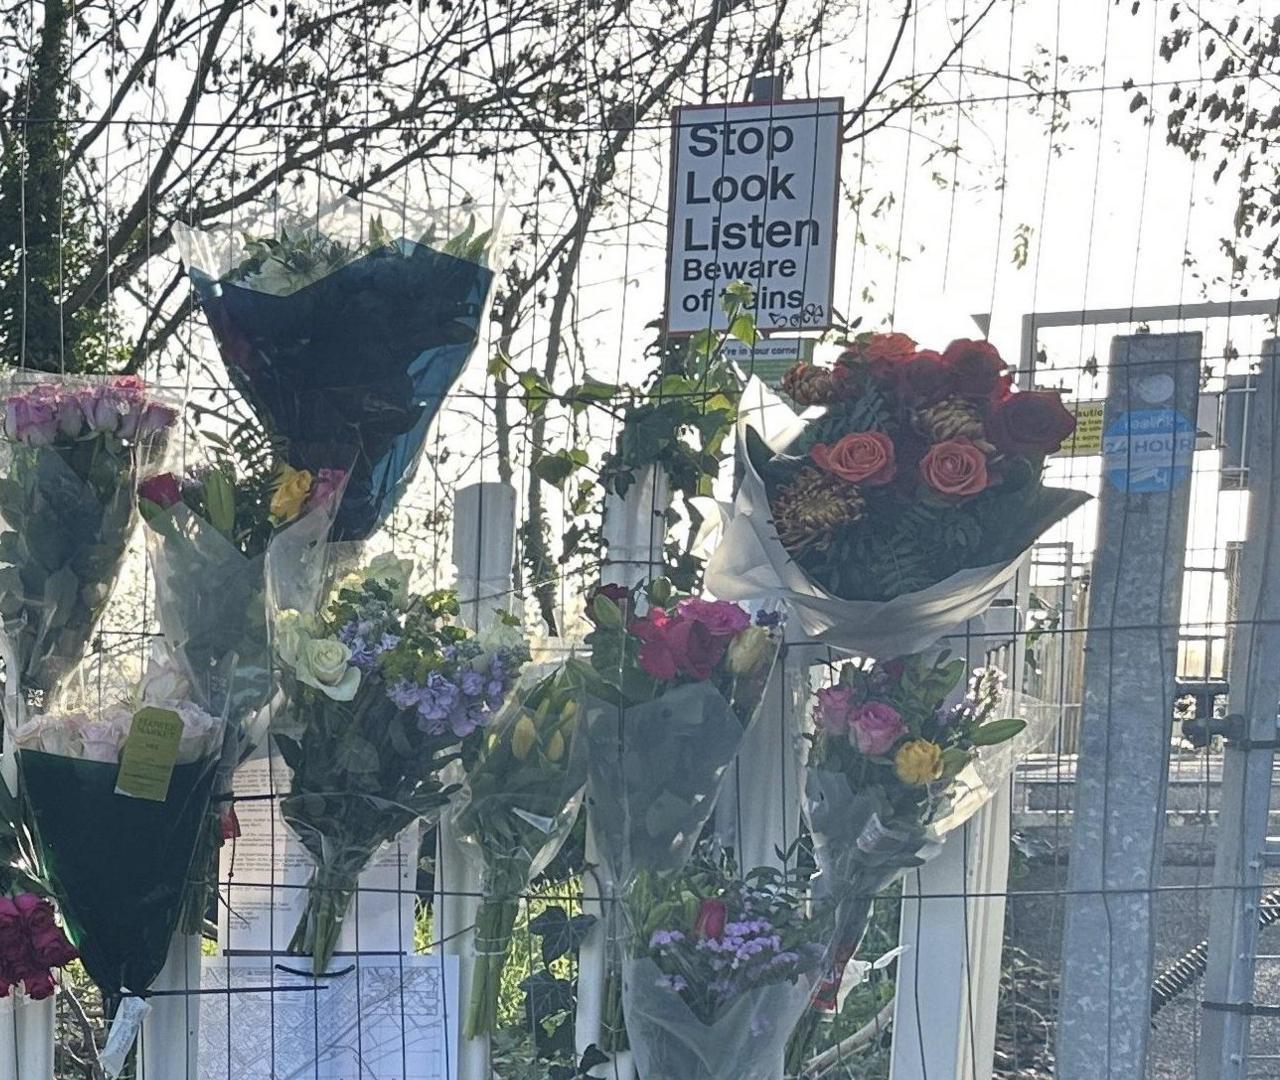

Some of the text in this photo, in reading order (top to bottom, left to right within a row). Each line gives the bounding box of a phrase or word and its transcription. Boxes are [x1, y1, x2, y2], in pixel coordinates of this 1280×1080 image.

[688, 122, 794, 160] Stop
[686, 166, 796, 205] Look
[684, 214, 820, 251] Listen
[682, 258, 797, 282] Beware
[682, 285, 805, 313] of ains
[1134, 438, 1192, 453] HOUR
